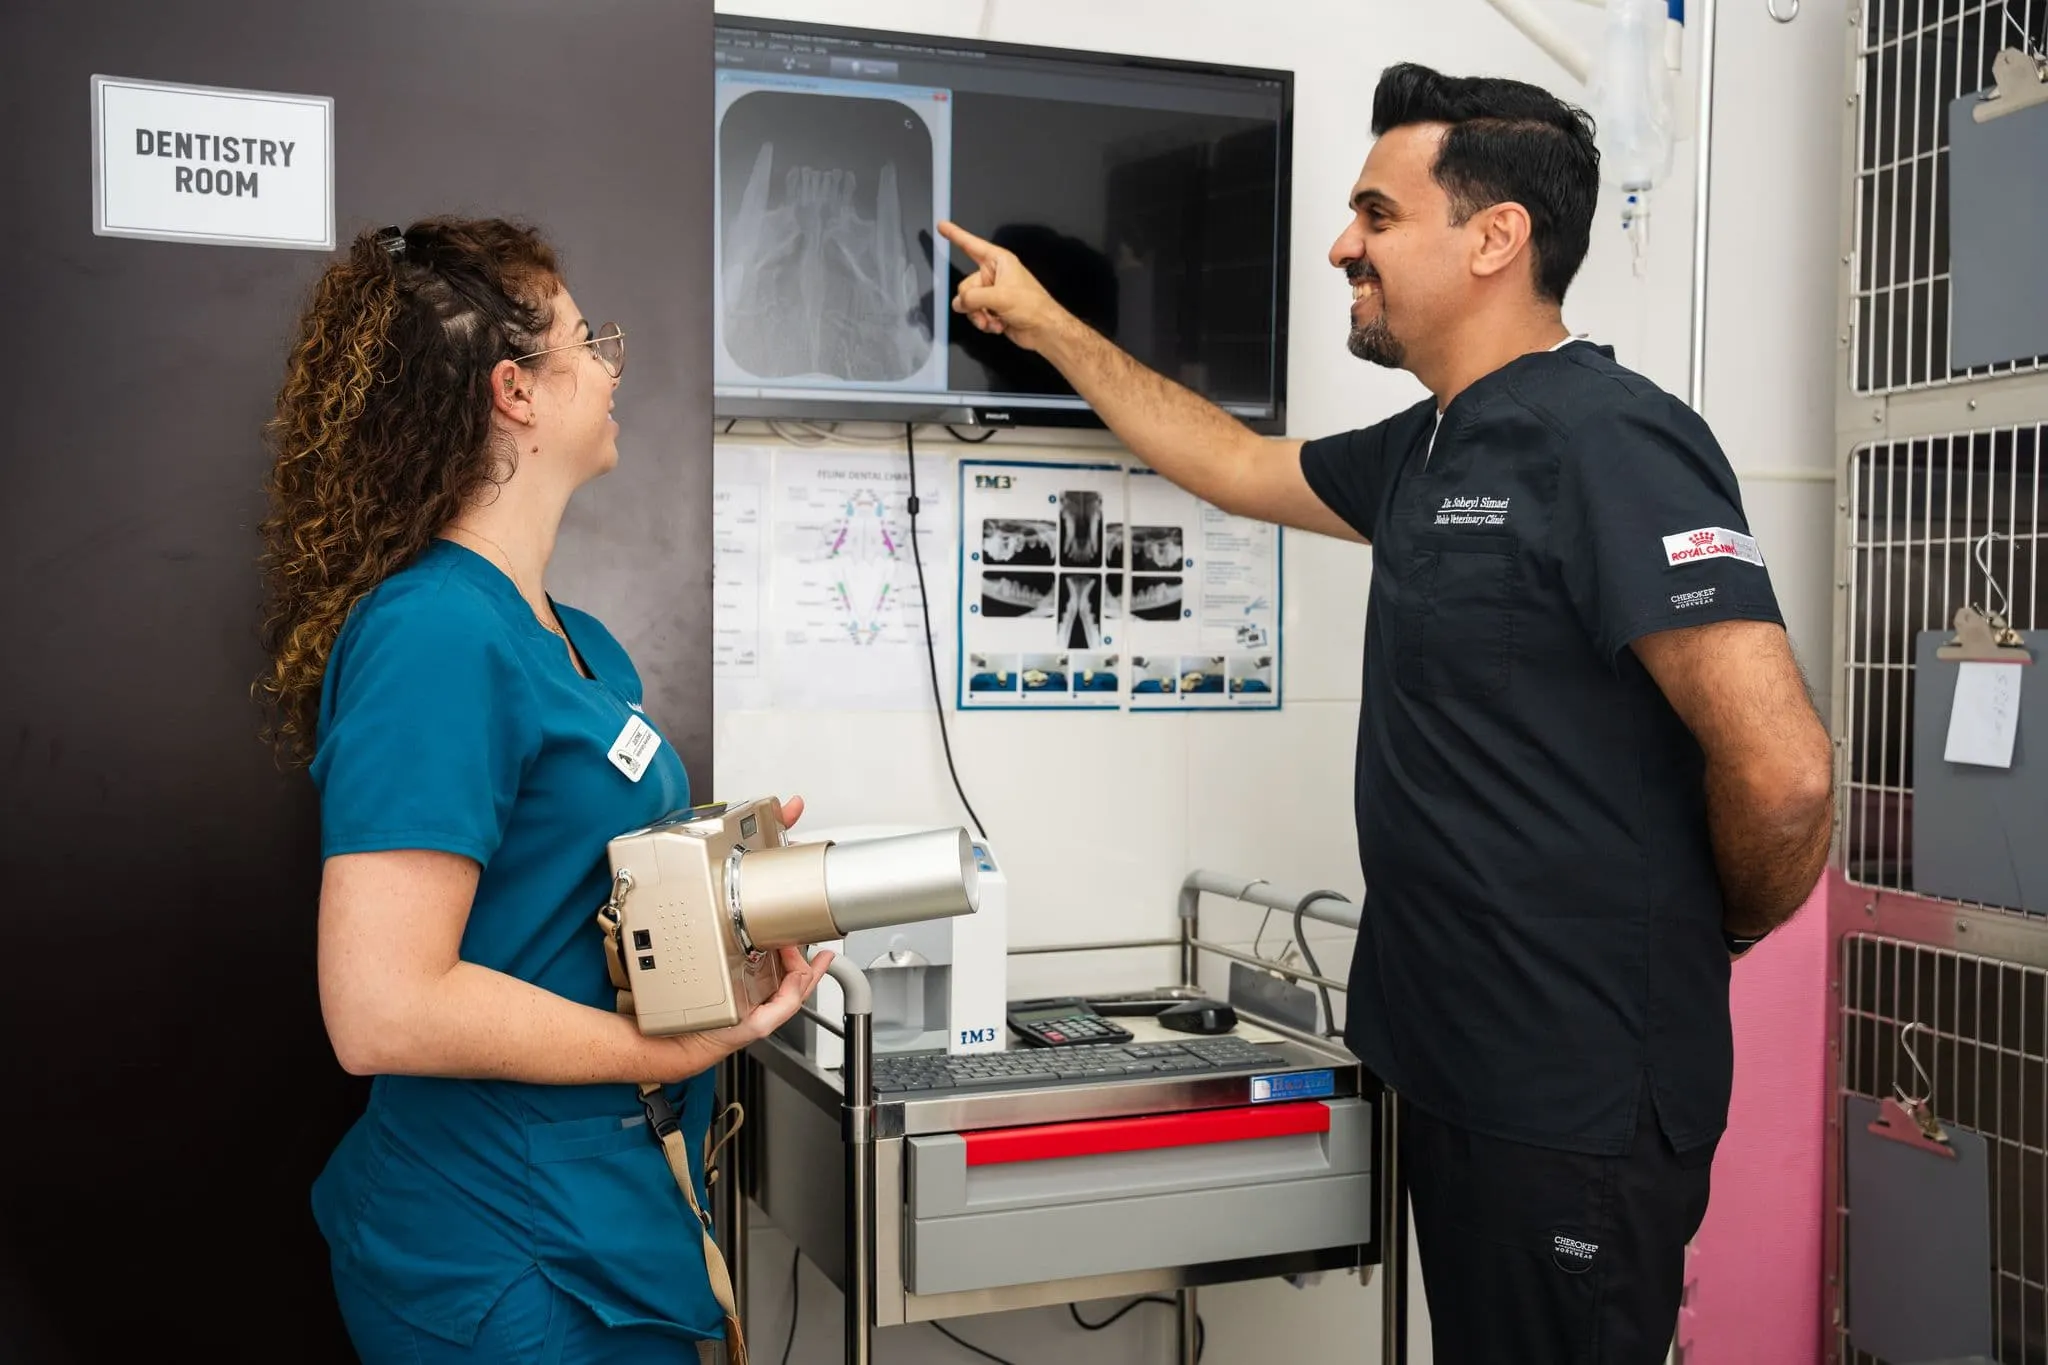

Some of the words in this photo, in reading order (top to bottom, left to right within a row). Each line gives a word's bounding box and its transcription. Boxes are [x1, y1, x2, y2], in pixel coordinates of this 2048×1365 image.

[136, 128, 295, 167] DENTISTRY
[175, 166, 258, 199] ROOM
[1671, 547, 1706, 561] ROYAL
[1671, 587, 1716, 603] CHEROKEE
[1554, 1236, 1599, 1253] CHEROKEE
